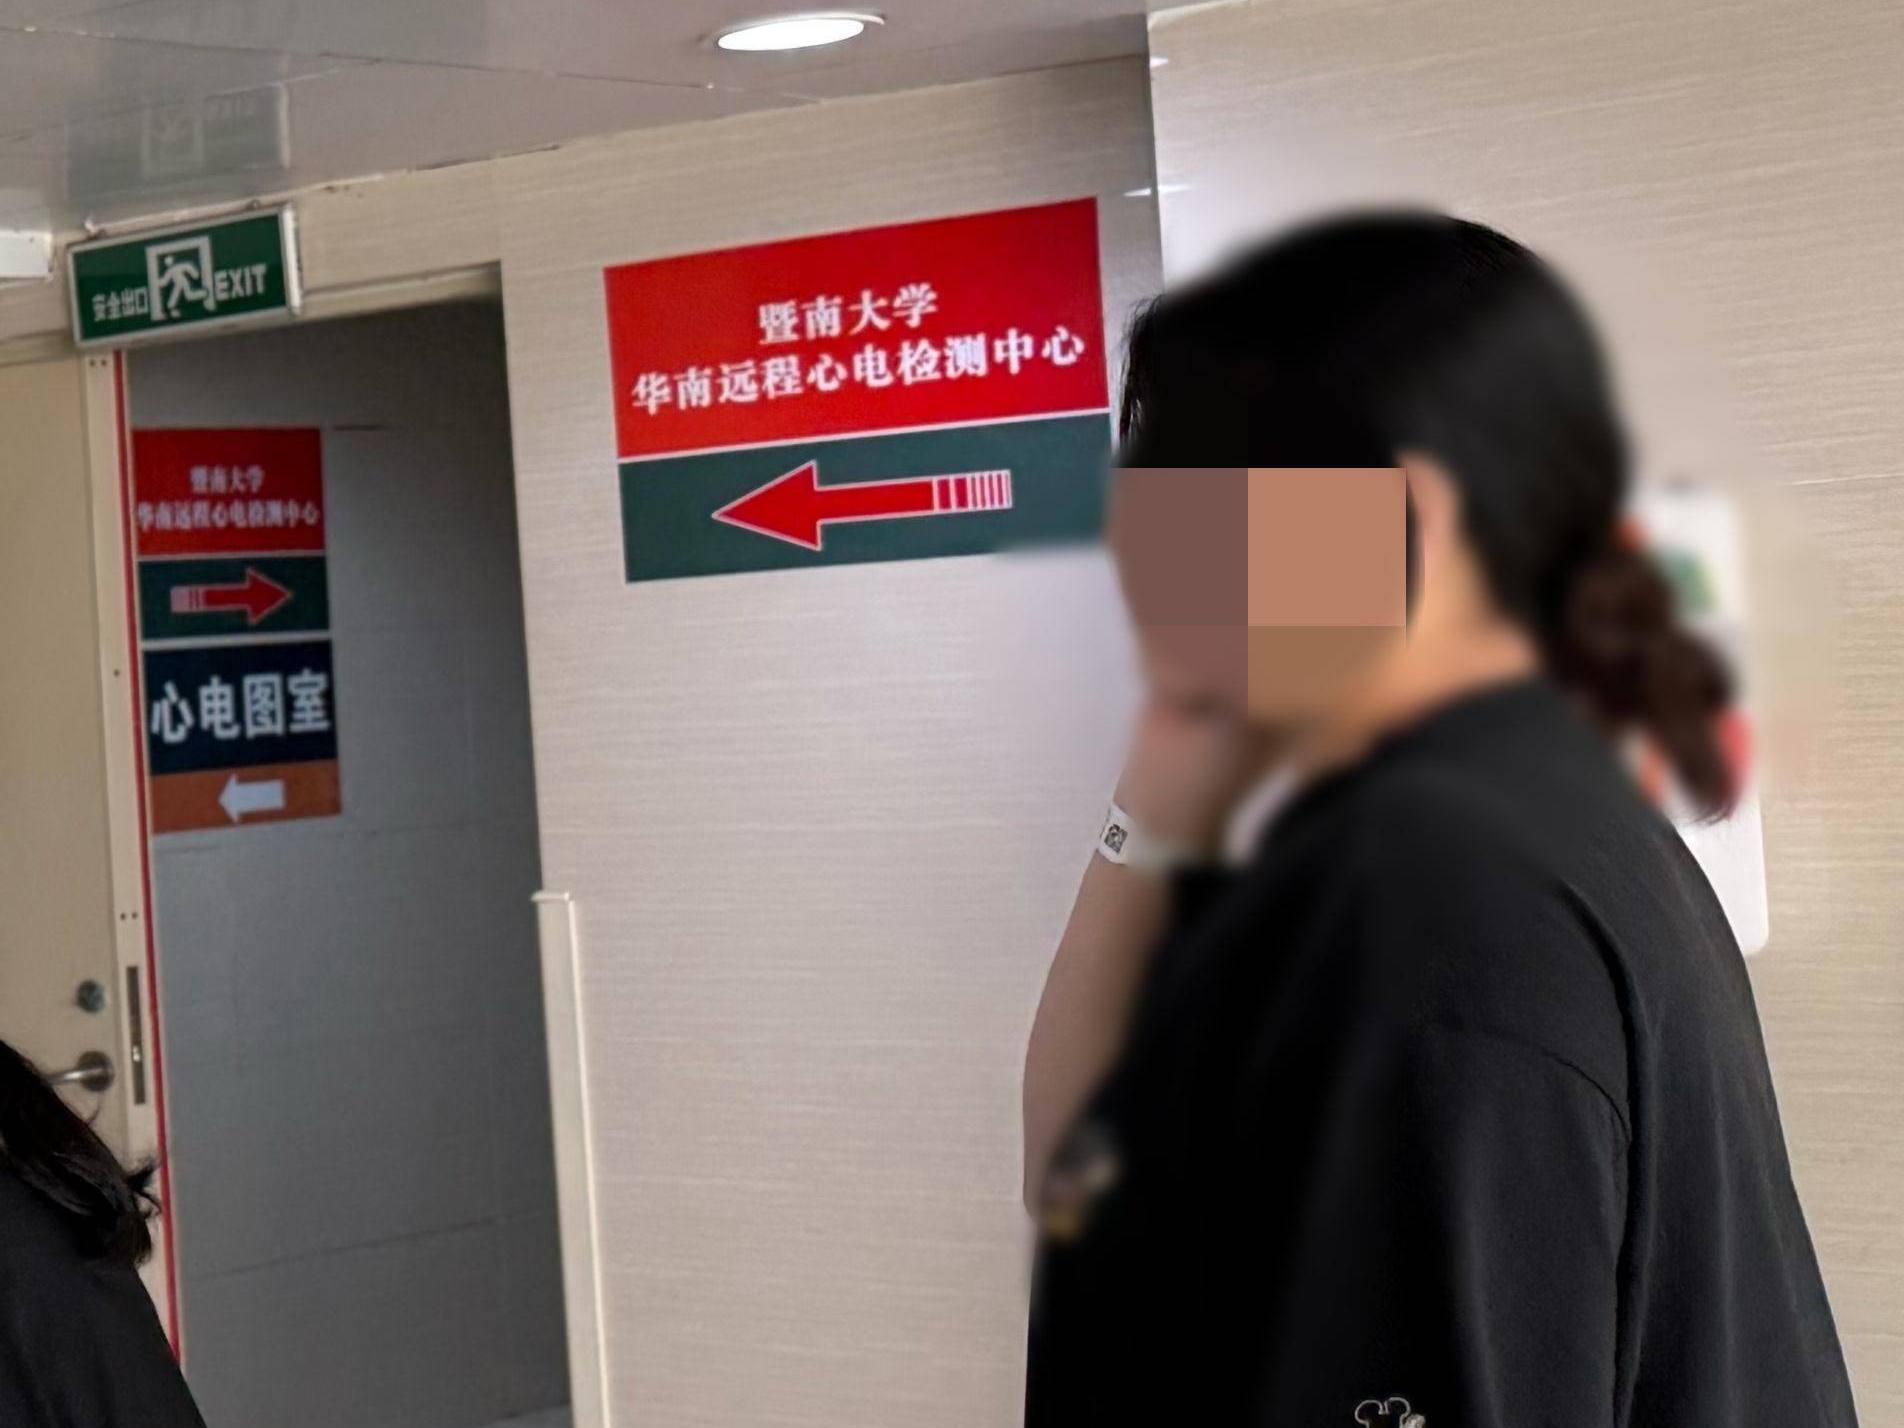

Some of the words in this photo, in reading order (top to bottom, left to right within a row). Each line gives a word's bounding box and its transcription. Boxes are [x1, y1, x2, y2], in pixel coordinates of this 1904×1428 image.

[93, 286, 149, 322] 安全出口
[214, 263, 267, 301] EXIT
[758, 282, 938, 344] 暨南大学
[631, 325, 1085, 414] 华南远程心电检测中心
[151, 668, 330, 743] 心电图室
